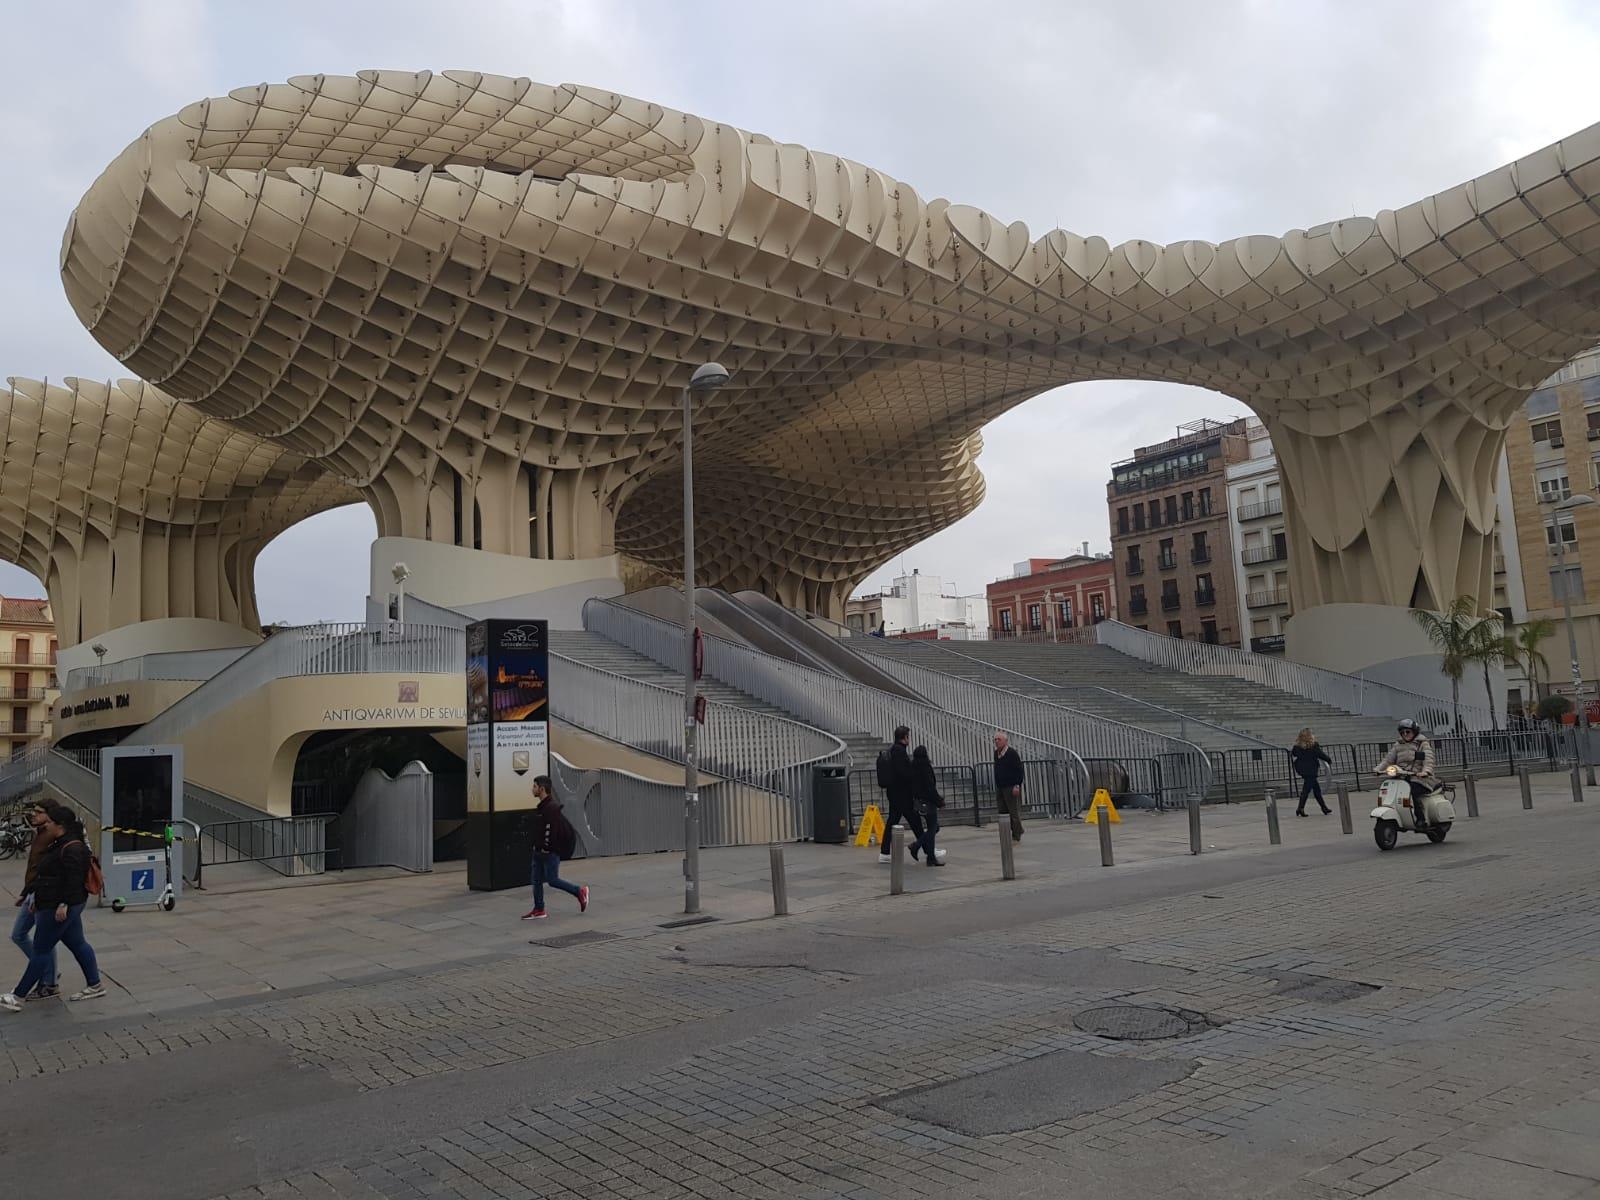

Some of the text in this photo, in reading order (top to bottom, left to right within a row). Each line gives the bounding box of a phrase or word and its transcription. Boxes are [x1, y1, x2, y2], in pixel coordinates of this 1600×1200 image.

[322, 707, 467, 722] ANTIQVARIVM DE SEVILLA
